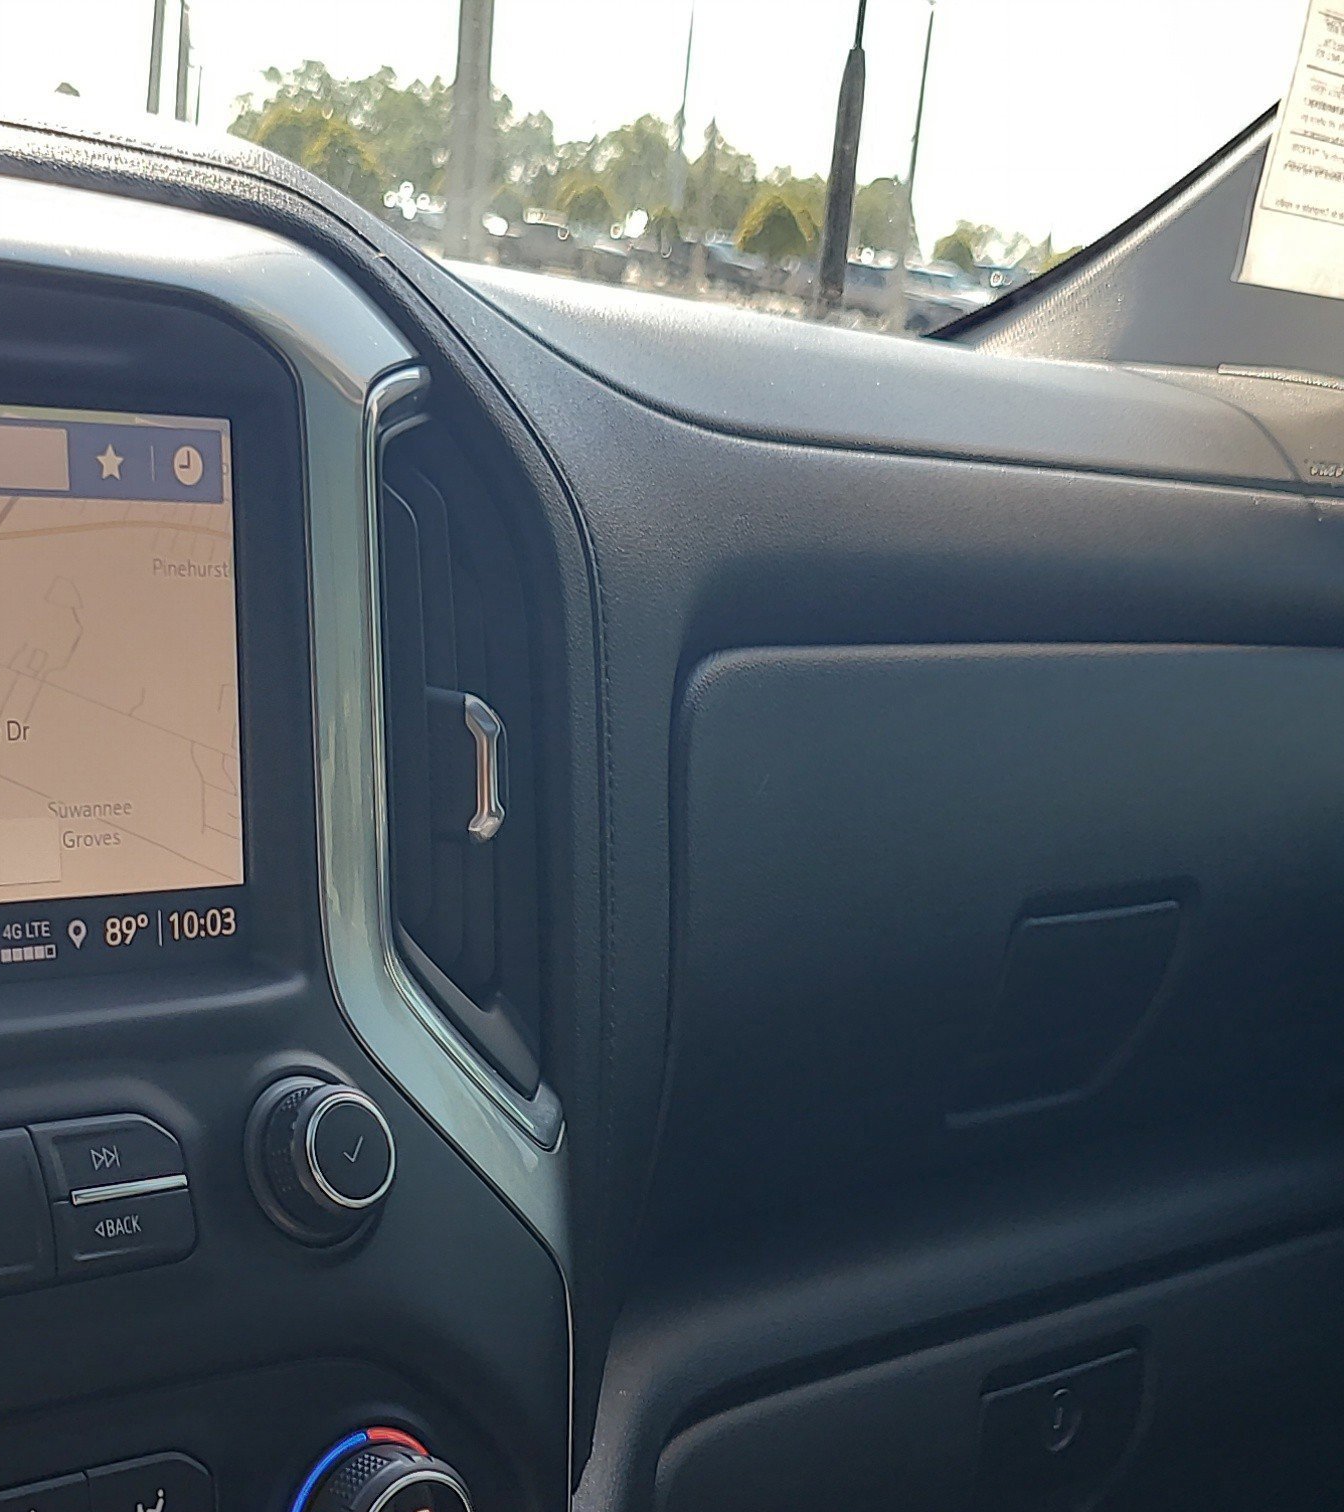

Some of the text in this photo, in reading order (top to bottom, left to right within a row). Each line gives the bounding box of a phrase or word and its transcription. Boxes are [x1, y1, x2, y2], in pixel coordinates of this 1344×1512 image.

[152, 558, 229, 578] Pinehurst
[6, 720, 31, 742] Dr
[47, 800, 133, 820] Suwannee
[61, 830, 122, 851] Groves
[2, 920, 52, 941] 4G LTE
[105, 914, 150, 946] 89°
[169, 907, 237, 941] 10:03
[106, 1214, 142, 1238] BACK
